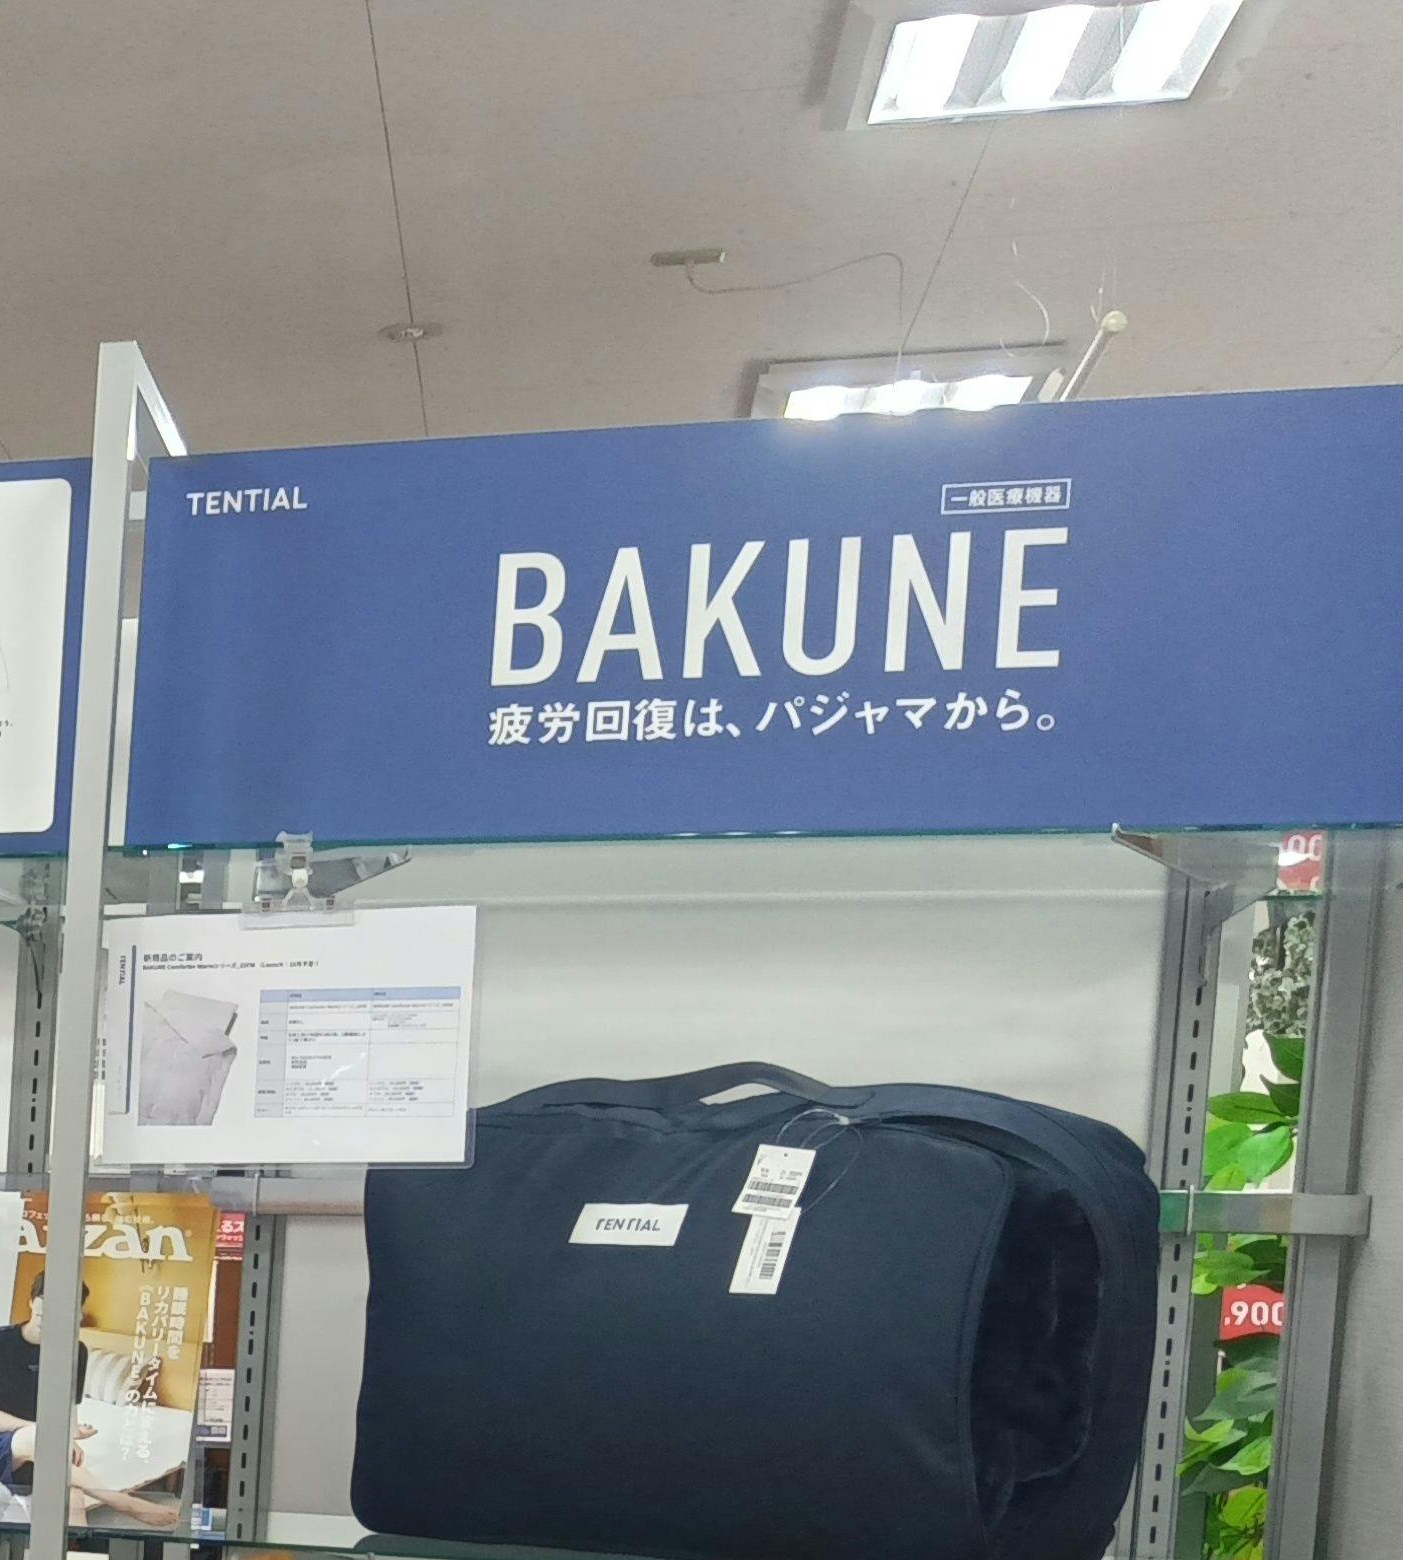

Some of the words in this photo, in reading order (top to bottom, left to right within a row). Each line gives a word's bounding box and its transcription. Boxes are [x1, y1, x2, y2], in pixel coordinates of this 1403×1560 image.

[185, 485, 307, 516] TENTIAL
[948, 483, 1065, 511] 一般医療機器
[489, 526, 1070, 687] BAKUNE
[487, 688, 1058, 746] 疲労回復は、パジャマから。
[595, 1218, 661, 1232] TENTIAL
